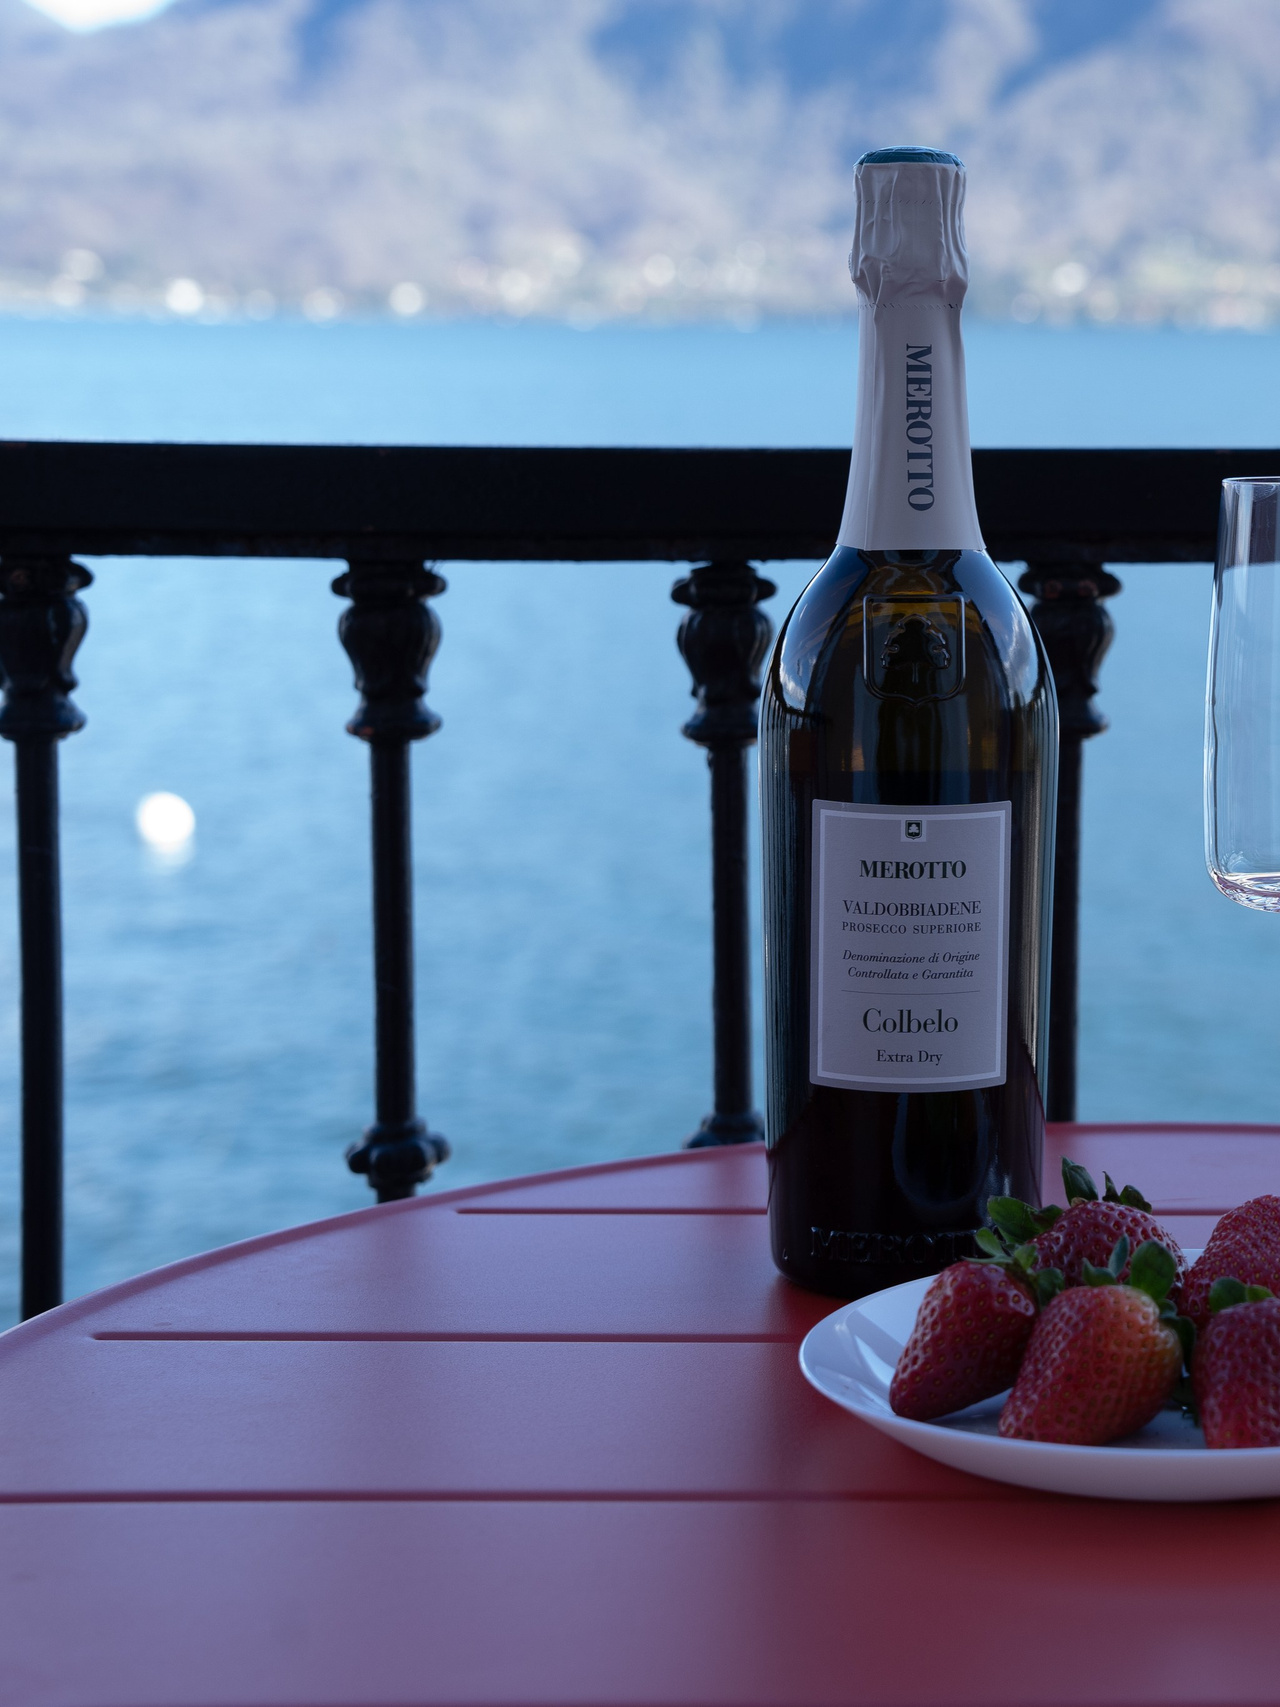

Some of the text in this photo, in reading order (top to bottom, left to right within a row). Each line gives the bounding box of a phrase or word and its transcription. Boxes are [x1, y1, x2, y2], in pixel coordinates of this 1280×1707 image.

[905, 343, 935, 511] MEROTTO
[859, 860, 966, 879] MEROTTO
[843, 900, 982, 916] VALDOBBIADENE
[842, 921, 982, 934] PROSECCO SUPERIORE
[842, 950, 980, 965] Denominazione di Origine
[847, 967, 909, 979] Controllata
[921, 968, 974, 980] Garantita
[862, 1008, 958, 1033] Colbelo
[876, 1050, 943, 1066] Extra Dry
